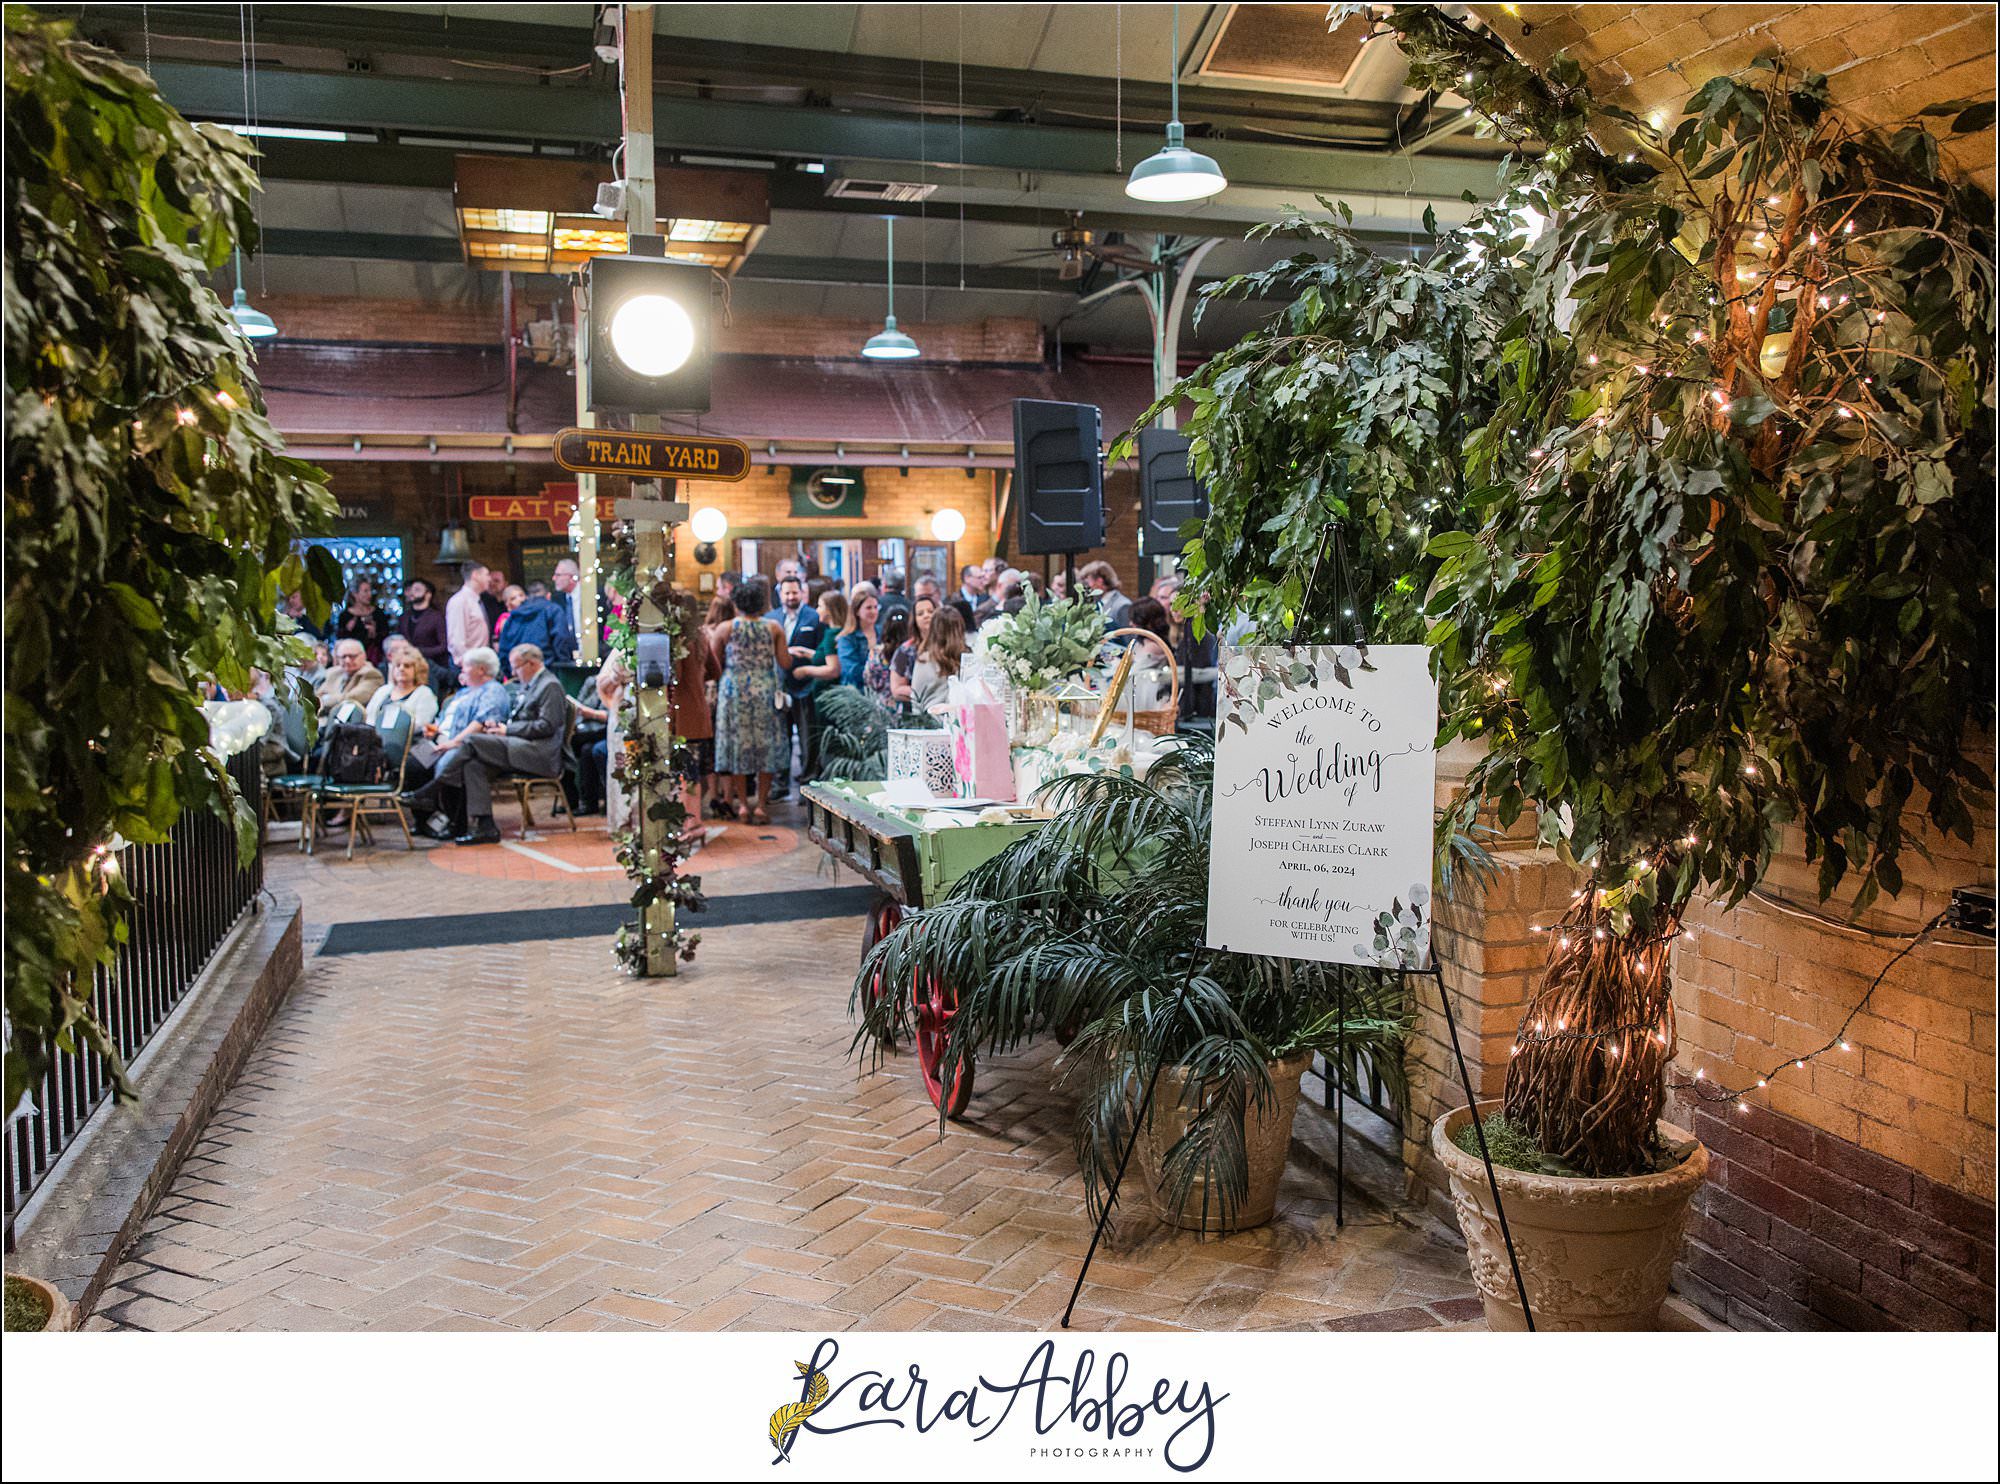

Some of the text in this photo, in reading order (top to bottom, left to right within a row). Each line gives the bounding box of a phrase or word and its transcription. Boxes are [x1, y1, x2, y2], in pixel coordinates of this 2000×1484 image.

[587, 441, 719, 470] TRAIN YARD
[1267, 696, 1381, 732] WELCOME TO
[1295, 724, 1315, 746] the
[1256, 742, 1381, 803] Wedding
[1343, 782, 1358, 807] of
[1254, 815, 1385, 833] STEFFANI LYNN ZURAW
[1248, 837, 1388, 857] JOSEPH CHARLES CLARK
[1313, 864, 1329, 874] 06,
[1331, 865, 1355, 876] 2024
[1278, 886, 1356, 923] thank you
[1269, 919, 1359, 935] FOR CELEBRATING
[1291, 931, 1336, 942] WITH US!
